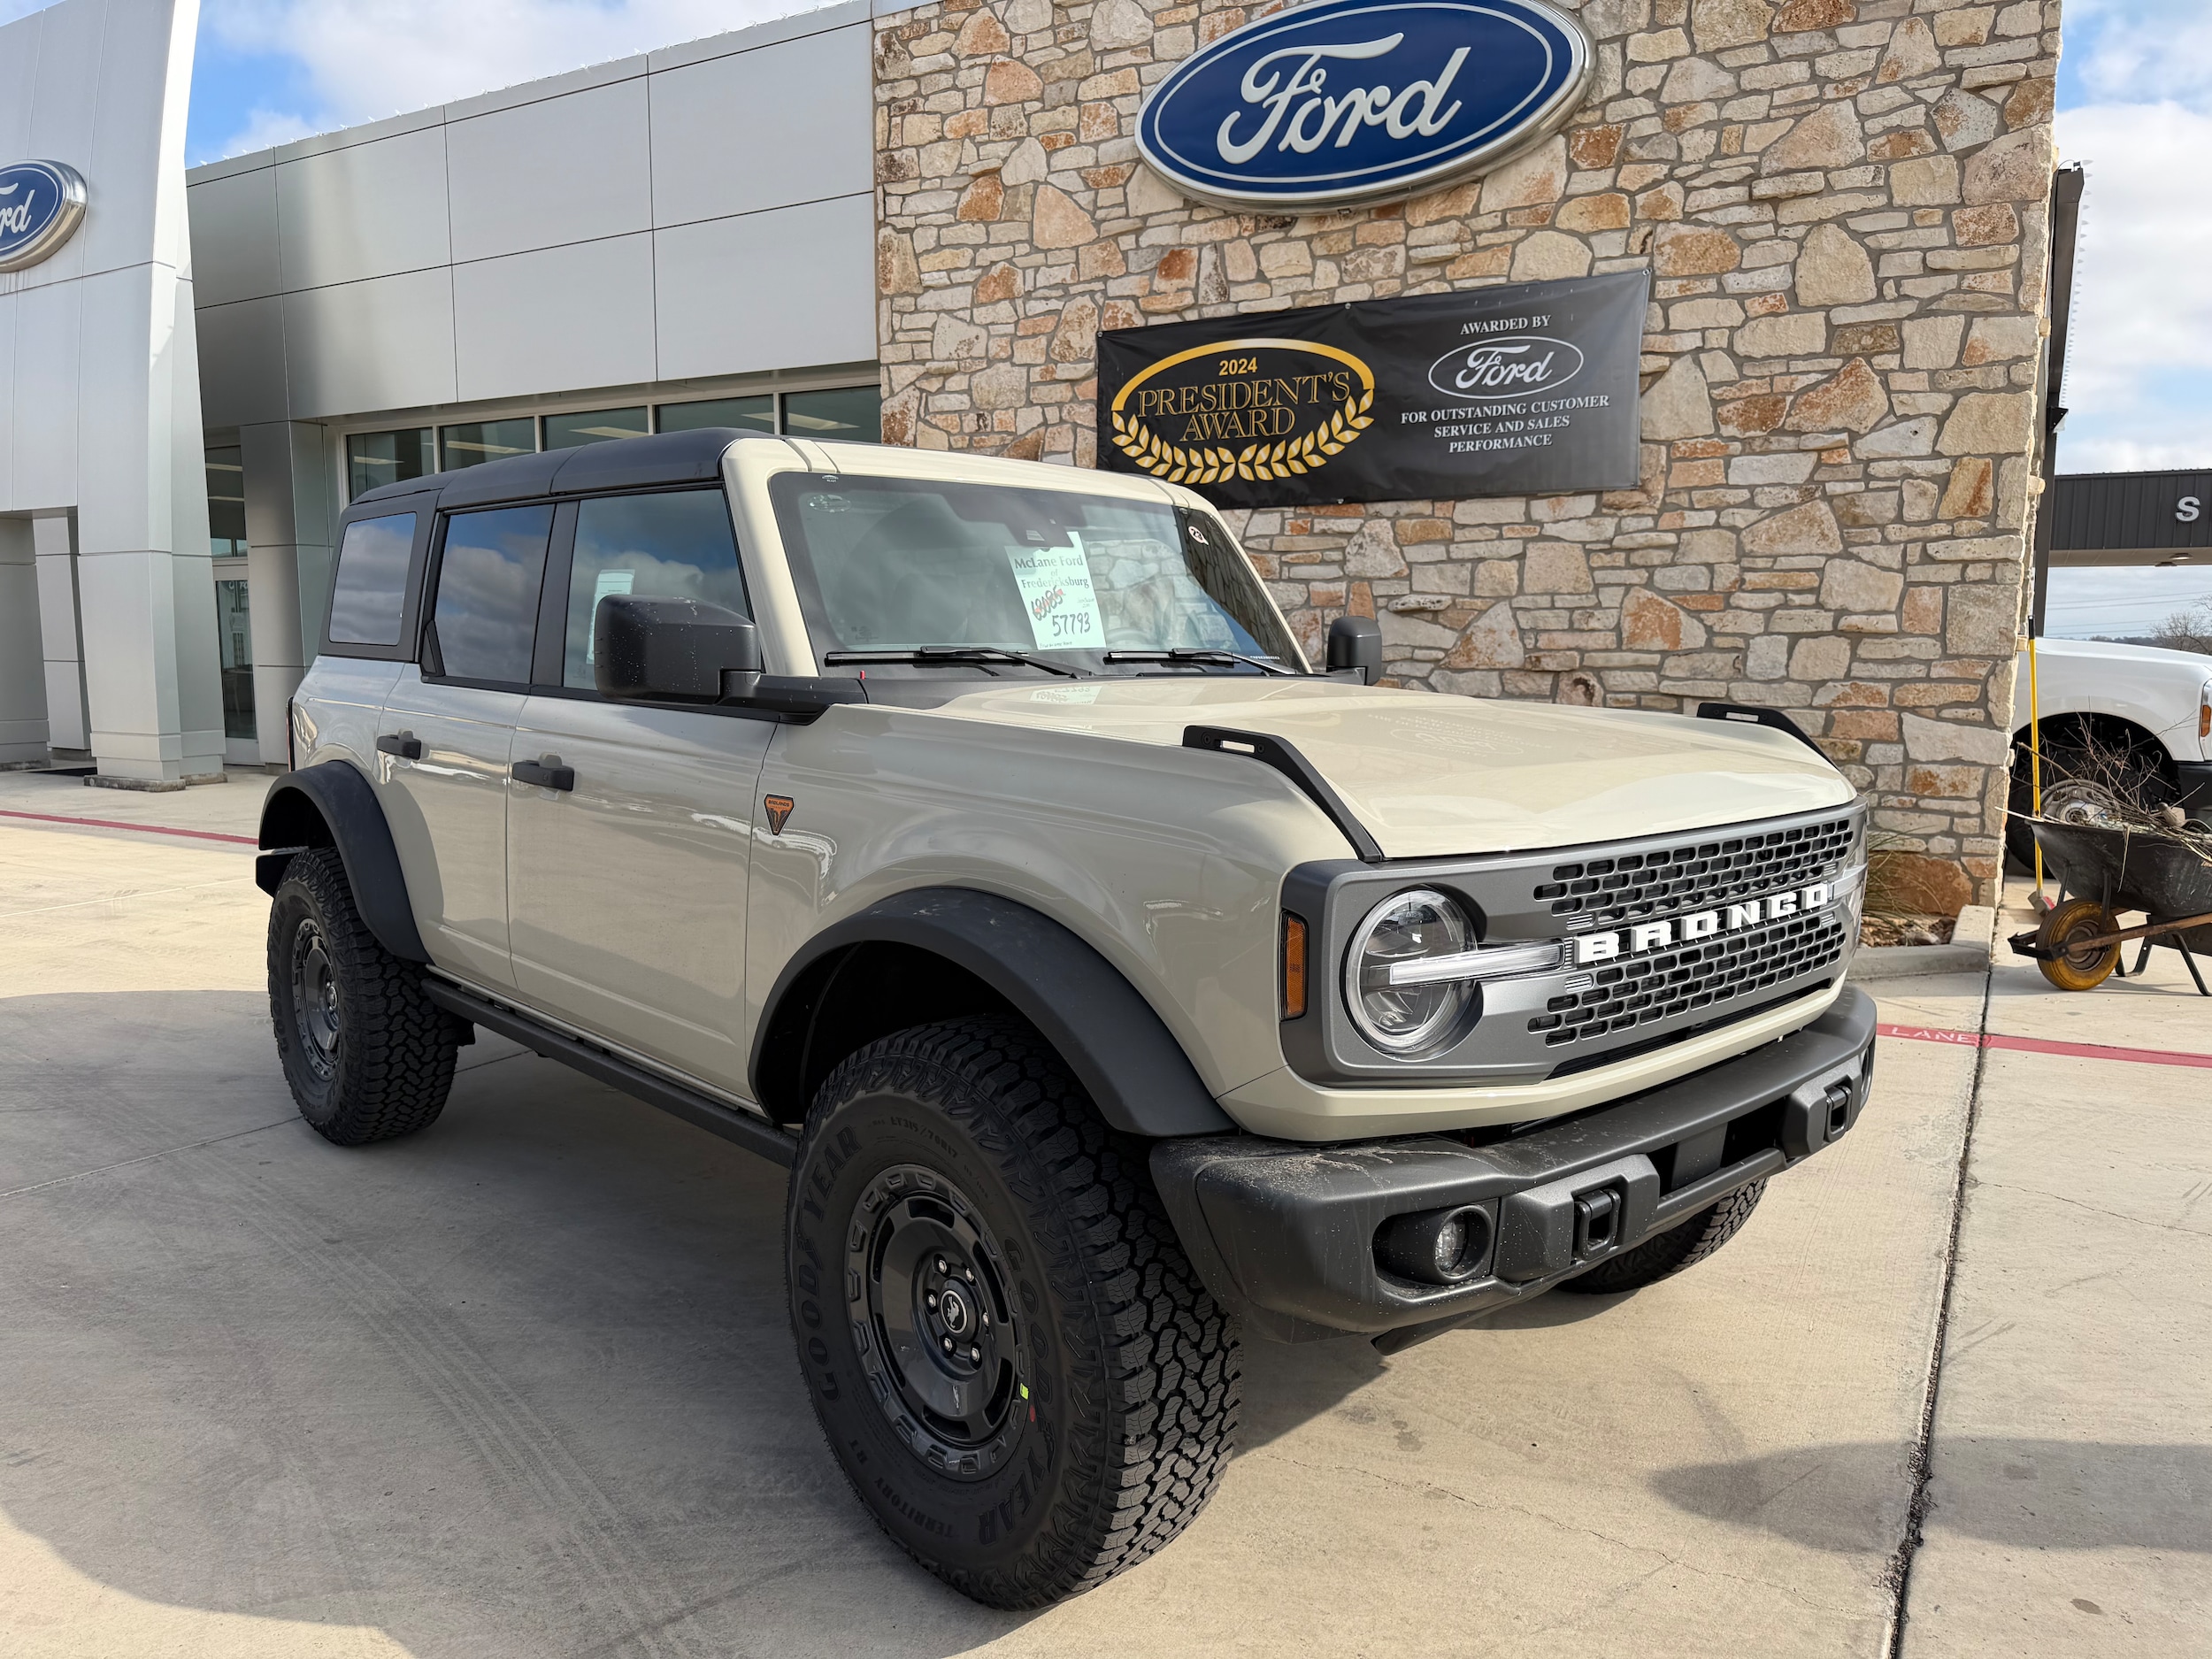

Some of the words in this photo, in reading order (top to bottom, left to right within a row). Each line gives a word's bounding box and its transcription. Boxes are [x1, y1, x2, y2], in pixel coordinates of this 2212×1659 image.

[1217, 32, 1471, 165] Ford
[0, 183, 35, 235] rd
[1460, 317, 1529, 335] AWARDED
[1532, 315, 1552, 328] BY
[1217, 357, 1258, 376] 2024
[1455, 344, 1555, 389] Ford
[1137, 372, 1351, 418] PRESIDENT'S
[1401, 411, 1427, 424] FOR
[1431, 403, 1527, 422] OUTSTANDING
[1531, 396, 1610, 414] CUSTOMER
[1179, 407, 1296, 442] AWARD
[1433, 423, 1492, 438] SERVICE
[1495, 421, 1525, 434] AND
[1527, 415, 1571, 431] SALES
[1448, 434, 1553, 453] PERFORMANCE
[2176, 496, 2200, 522] S
[1014, 557, 1056, 569] McLane
[1060, 555, 1084, 566] Ford
[1021, 576, 1090, 588] Fredericksburg
[1052, 611, 1091, 637] 57793
[1574, 883, 1829, 964] BRONCO
[1891, 1026, 1978, 1044] LANE
[873, 1477, 958, 1539] TERRITORY
